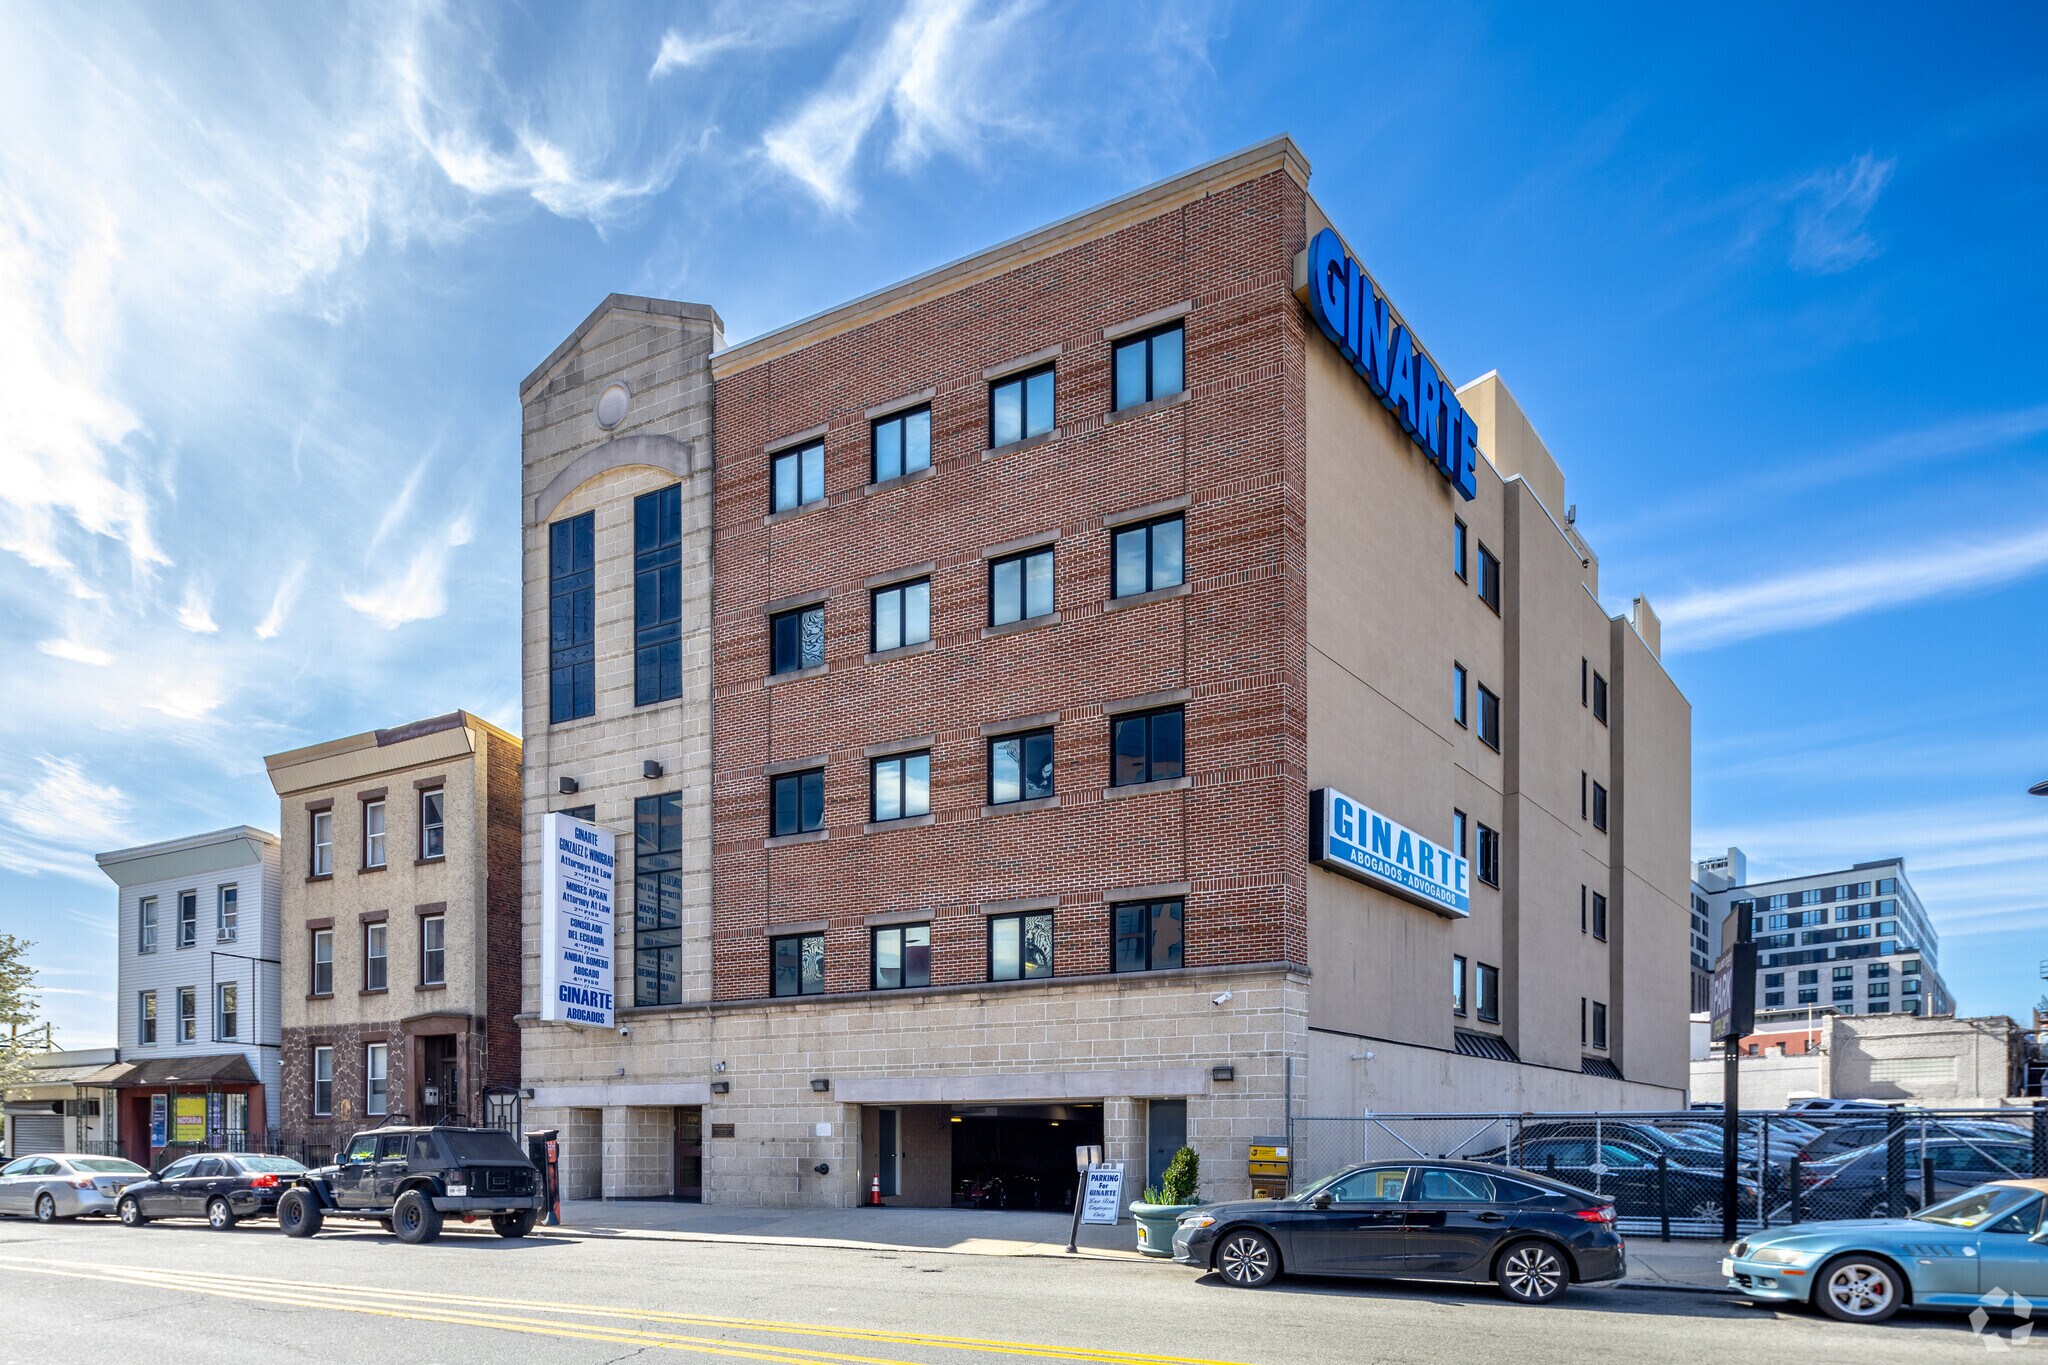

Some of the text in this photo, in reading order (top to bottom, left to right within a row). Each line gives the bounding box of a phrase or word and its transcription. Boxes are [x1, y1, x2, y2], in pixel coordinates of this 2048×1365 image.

[1308, 227, 1478, 502] GINARTE
[575, 827, 598, 846] GINARTE
[1334, 797, 1467, 894] GINARTE
[560, 838, 583, 857] GONZALEZ
[589, 848, 614, 867] WINOGRAD
[561, 855, 612, 879] Attorneys At Law
[1350, 848, 1456, 905] ABOGADOS ADVOGADOS
[566, 881, 608, 902] MOISES APSAN
[563, 892, 610, 914] Attorney At Law
[570, 918, 602, 934] CONSULADO
[568, 930, 604, 947] DEL ECUADOR
[564, 952, 608, 969] ANIBAL ROMERO
[574, 966, 599, 979] ABOGADO
[559, 985, 612, 1010] GINARTE
[1713, 969, 1732, 1017] PARK
[567, 1007, 604, 1024] ABOGADOS
